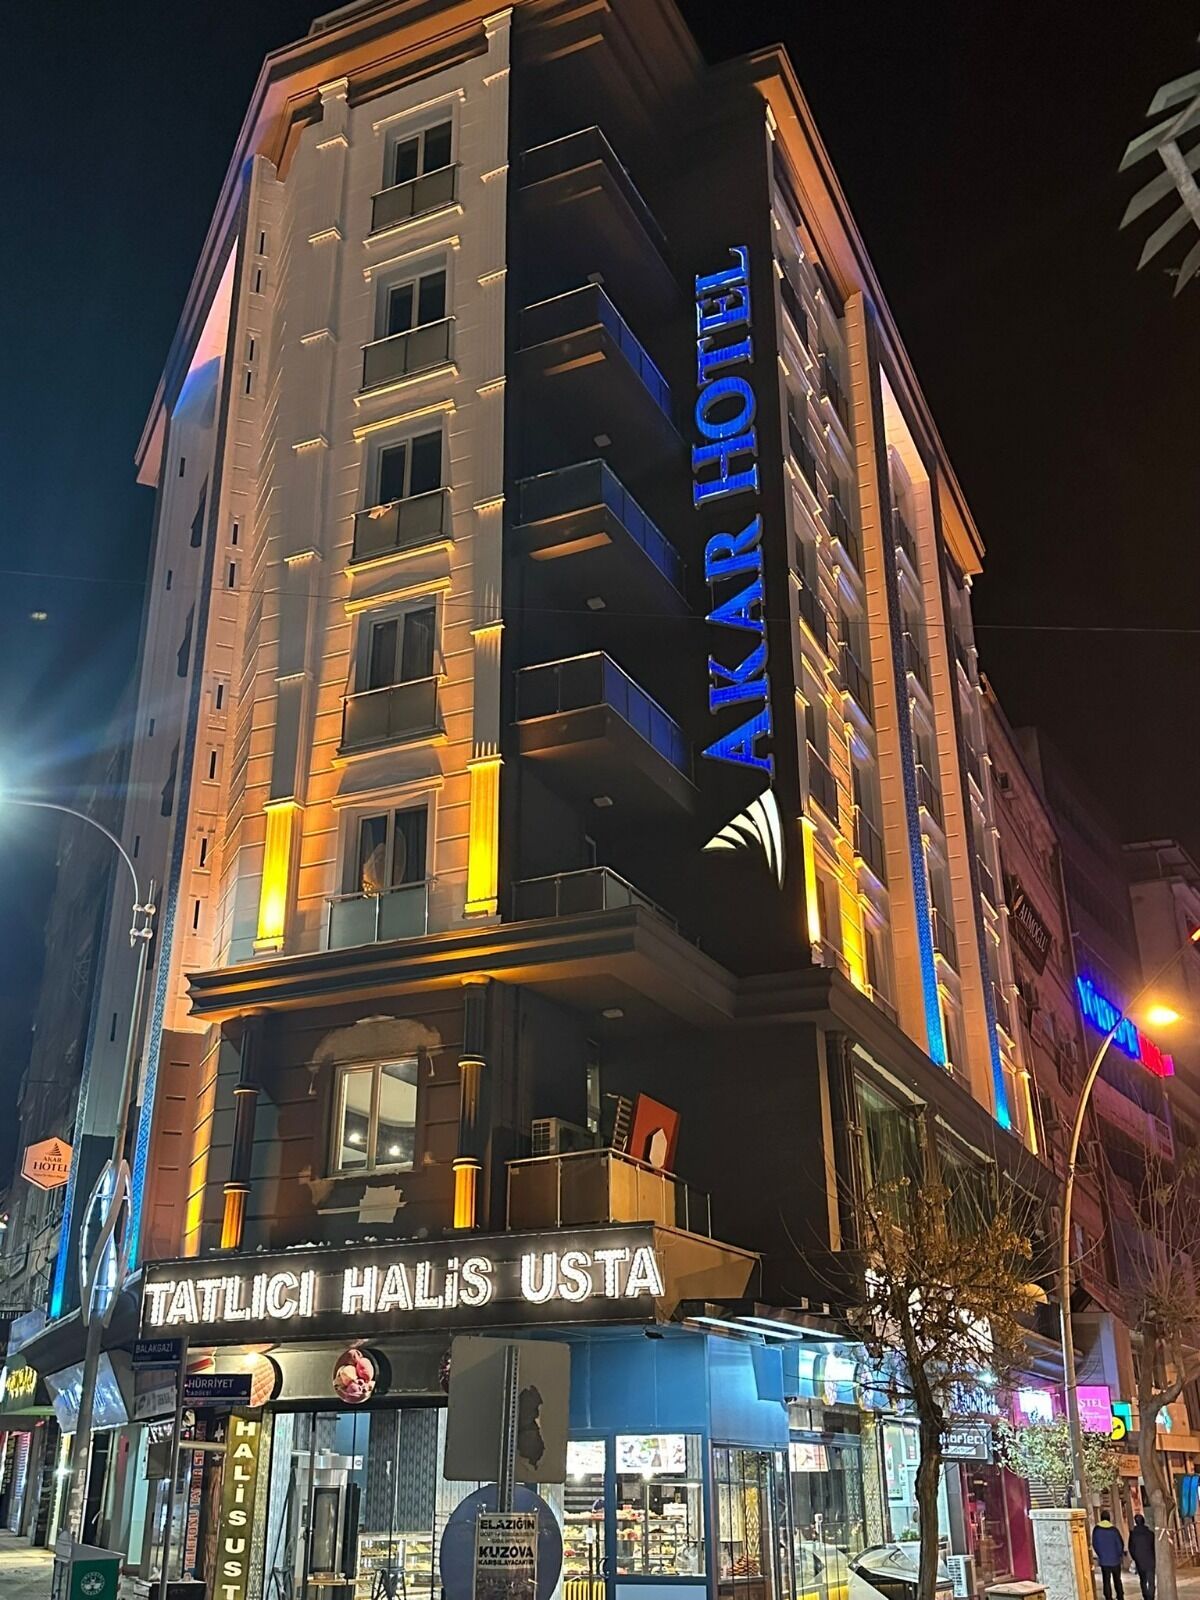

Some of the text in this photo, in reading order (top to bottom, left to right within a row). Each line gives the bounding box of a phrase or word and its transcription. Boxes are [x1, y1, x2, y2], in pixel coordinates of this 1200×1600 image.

[692, 245, 775, 780] AKAR HOTEL
[34, 1161, 69, 1172] HOTEL
[145, 1268, 316, 1327] TATLICI
[519, 1246, 666, 1305] USTA
[135, 1342, 174, 1354] BALAKGAZİ
[187, 1377, 235, 1389] HÜRRİYET
[184, 1508, 200, 1570] TELEFONU
[479, 1546, 534, 1558] KUZOVA
